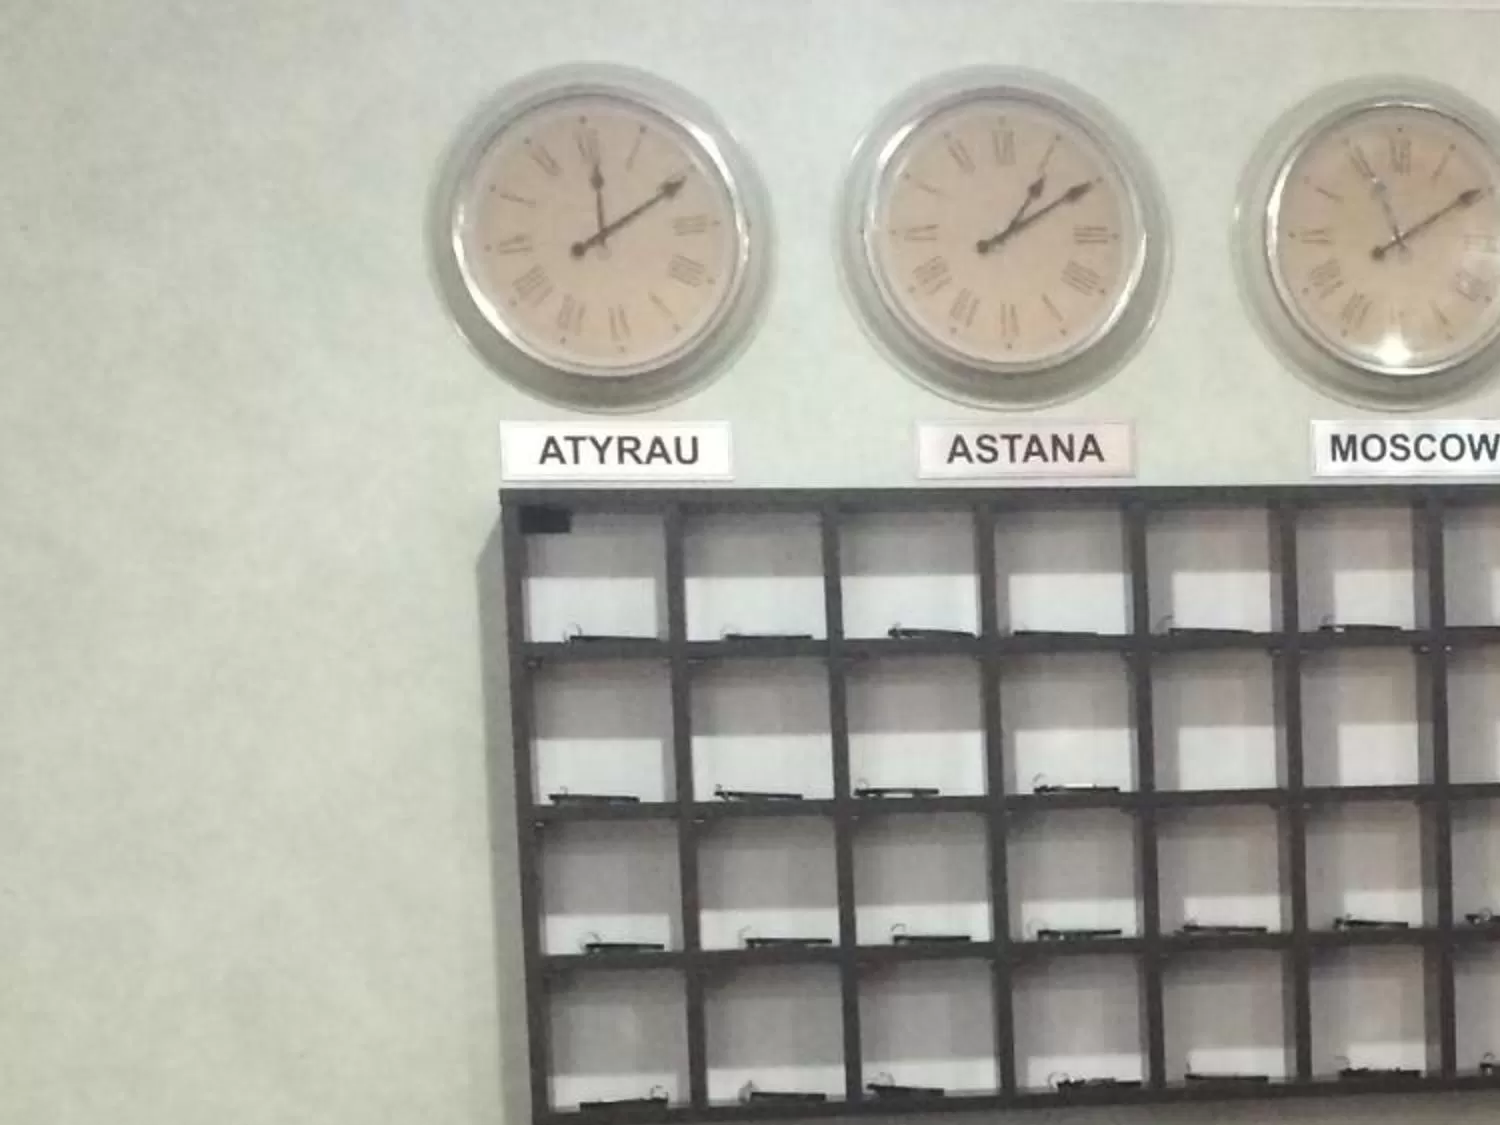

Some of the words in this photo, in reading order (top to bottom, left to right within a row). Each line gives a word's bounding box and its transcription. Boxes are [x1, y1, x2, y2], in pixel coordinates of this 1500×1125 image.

[539, 435, 699, 465] ATYRAU
[947, 433, 1105, 464] ASTANA
[1330, 433, 1500, 463] MOSCOW
